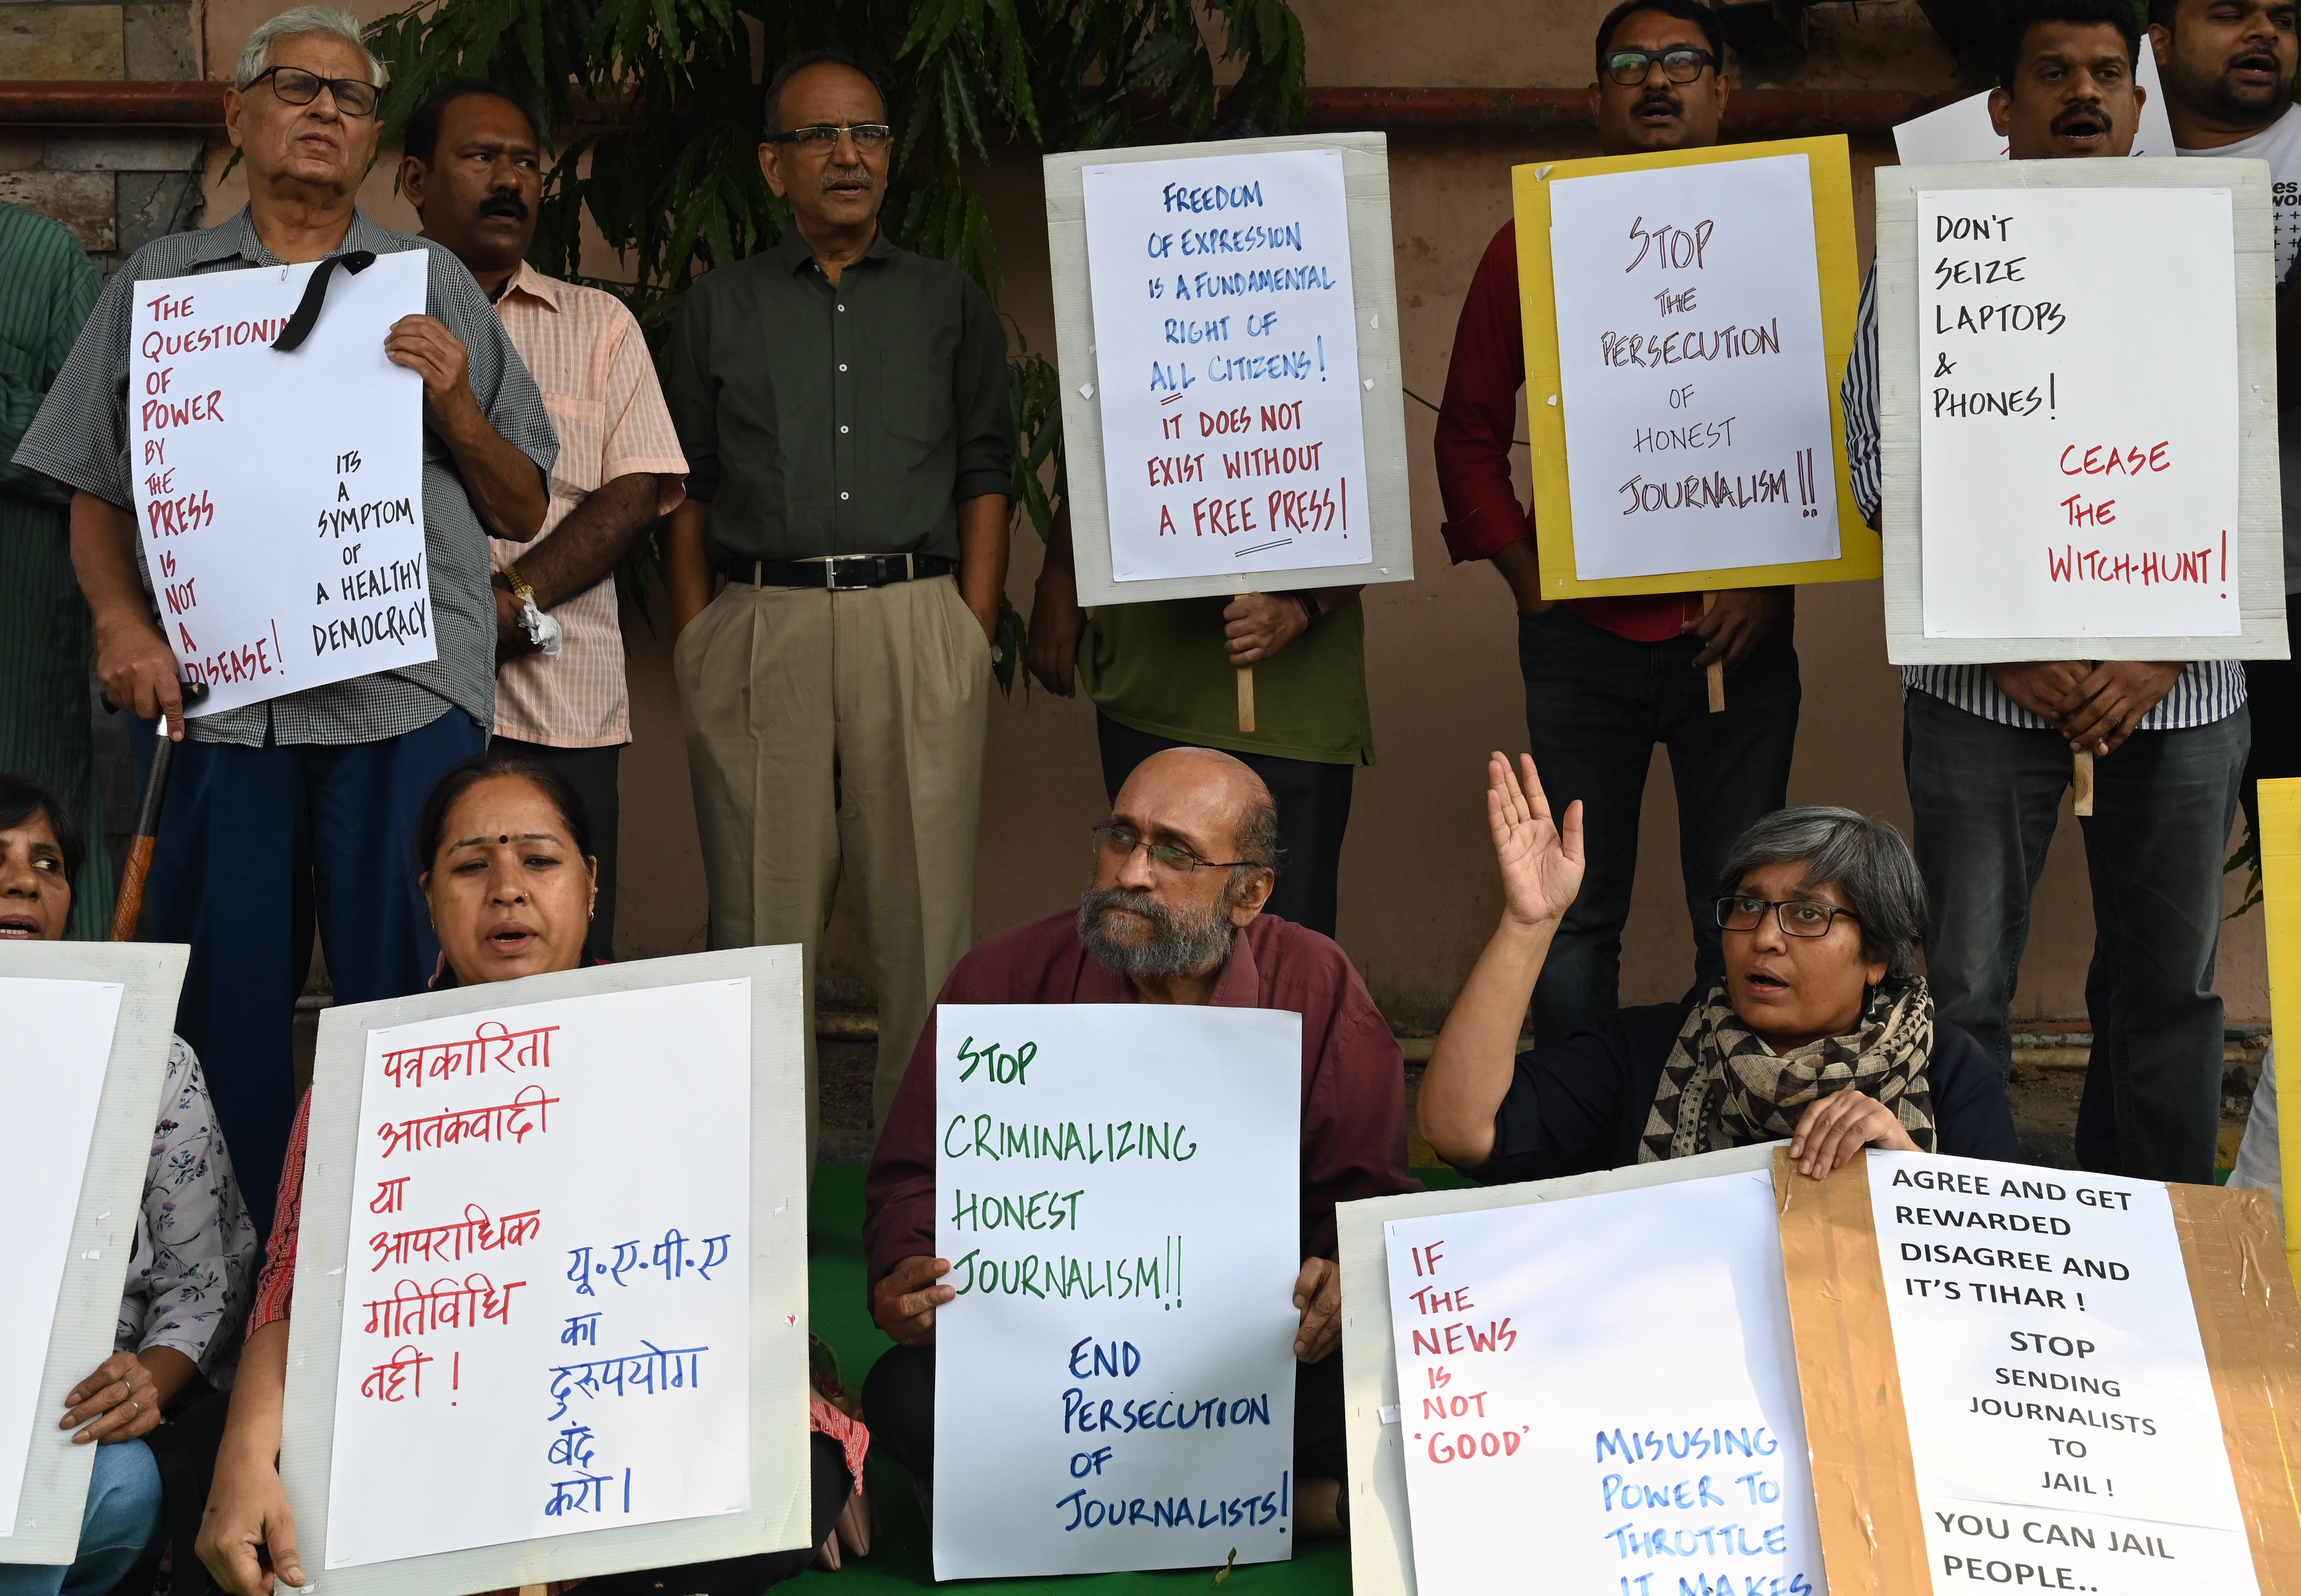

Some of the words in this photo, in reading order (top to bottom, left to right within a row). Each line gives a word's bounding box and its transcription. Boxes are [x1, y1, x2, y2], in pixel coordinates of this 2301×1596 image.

[1163, 181, 1263, 213] FREEDOM
[2271, 181, 2298, 194] es
[2272, 194, 2301, 207] wo
[1148, 232, 1173, 258] OF
[1181, 221, 1302, 255] EXPRESSION
[1625, 216, 1714, 273] STOP
[1937, 215, 2014, 242] DON'T
[1149, 277, 1164, 299] IS
[1177, 274, 1190, 300] A
[1194, 265, 1335, 298] FUNDAMENTAL
[1935, 257, 2027, 290] SEIZE
[147, 294, 194, 321] THE
[1654, 287, 1696, 317] THE
[1936, 302, 2066, 335] LAPTOPS
[142, 313, 292, 363] QUESTIONIN
[1165, 316, 1230, 344] RIGHT
[1247, 311, 1277, 336] OF
[1601, 317, 1780, 368] PERSECUTION
[146, 367, 173, 395] OF
[1150, 361, 1196, 391] ALL
[1205, 335, 1326, 382] CITIZENS!
[1934, 352, 1957, 378] &
[142, 389, 224, 432] POWER
[1670, 384, 1694, 409] OF
[1933, 372, 2055, 420] PHONES!
[1163, 414, 1182, 439] IT
[1200, 406, 1251, 437] DOES
[1261, 400, 1302, 432] NOT
[1633, 417, 1736, 452] HONEST
[145, 438, 165, 465] BY
[337, 451, 361, 474] ITS
[1147, 454, 1204, 487] EXIST
[1223, 442, 1322, 479] WITHOUT
[2060, 441, 2170, 476] CEASE
[145, 467, 175, 496] THE
[338, 481, 349, 502] A
[148, 489, 213, 539] PRESS
[318, 497, 414, 538] SYMPTOM
[1160, 505, 1176, 536] A
[1193, 497, 1256, 537] FREE
[1268, 477, 1347, 539] PRESS!
[2060, 494, 2116, 528] THE
[159, 550, 175, 577] IS
[343, 543, 361, 565] OF
[2048, 530, 2226, 599] WITCH-HUNT!
[165, 577, 196, 615] NOT
[317, 583, 329, 605] A
[341, 553, 425, 603] HEALTHY
[178, 622, 197, 654] A
[313, 597, 427, 656] DEMOCRACY
[183, 619, 284, 686] DISEASE!
[381, 1022, 560, 1088] पत्रकारिता
[957, 1036, 1037, 1085] STOP
[377, 1085, 560, 1158] आतंकवादी
[945, 1114, 1197, 1164] CRIMINALIZING
[370, 1176, 410, 1214] या
[1892, 1169, 1990, 1195] AGREE
[2001, 1180, 2066, 1200] AND
[2076, 1189, 2131, 1210] GET
[951, 1189, 1084, 1231] HONEST
[1896, 1206, 2070, 1235] REWARDED
[369, 1203, 540, 1272] आपराधिक
[1412, 1240, 1444, 1276] IF
[1901, 1243, 2052, 1272] DISAGREE
[2063, 1257, 2129, 1280] AND
[363, 1273, 526, 1338] गतिविधि
[1409, 1286, 1474, 1315] THE
[1969, 1283, 2066, 1309] TIHAR
[561, 1312, 603, 1346] का
[1413, 1318, 1517, 1355] NEWS
[2010, 1331, 2095, 1359] STOP
[361, 1345, 433, 1402] नहीं
[1068, 1336, 1141, 1379] END
[1428, 1366, 1451, 1389] IS
[1996, 1368, 2120, 1397] SENDING
[1062, 1387, 1271, 1434] PERSECUTION
[1423, 1392, 1487, 1419] NOT
[1970, 1397, 2156, 1435] JOURNALISTS
[548, 1421, 594, 1469] बंद
[1070, 1445, 1113, 1479] OF
[1596, 1428, 1778, 1464] MISUSING
[2048, 1438, 2087, 1458] TO
[545, 1471, 613, 1516] करो
[1602, 1474, 1724, 1511] POWER
[1735, 1471, 1779, 1504] TO
[2042, 1471, 2097, 1494] JAIL
[1056, 1471, 1288, 1534] JOURNALISTS!
[1605, 1523, 1787, 1559] THROTTLE
[1935, 1512, 2009, 1539] YOU
[2023, 1522, 2096, 1549] CAN
[2108, 1531, 2174, 1559] JAIL
[1621, 1572, 1653, 1596] IT
